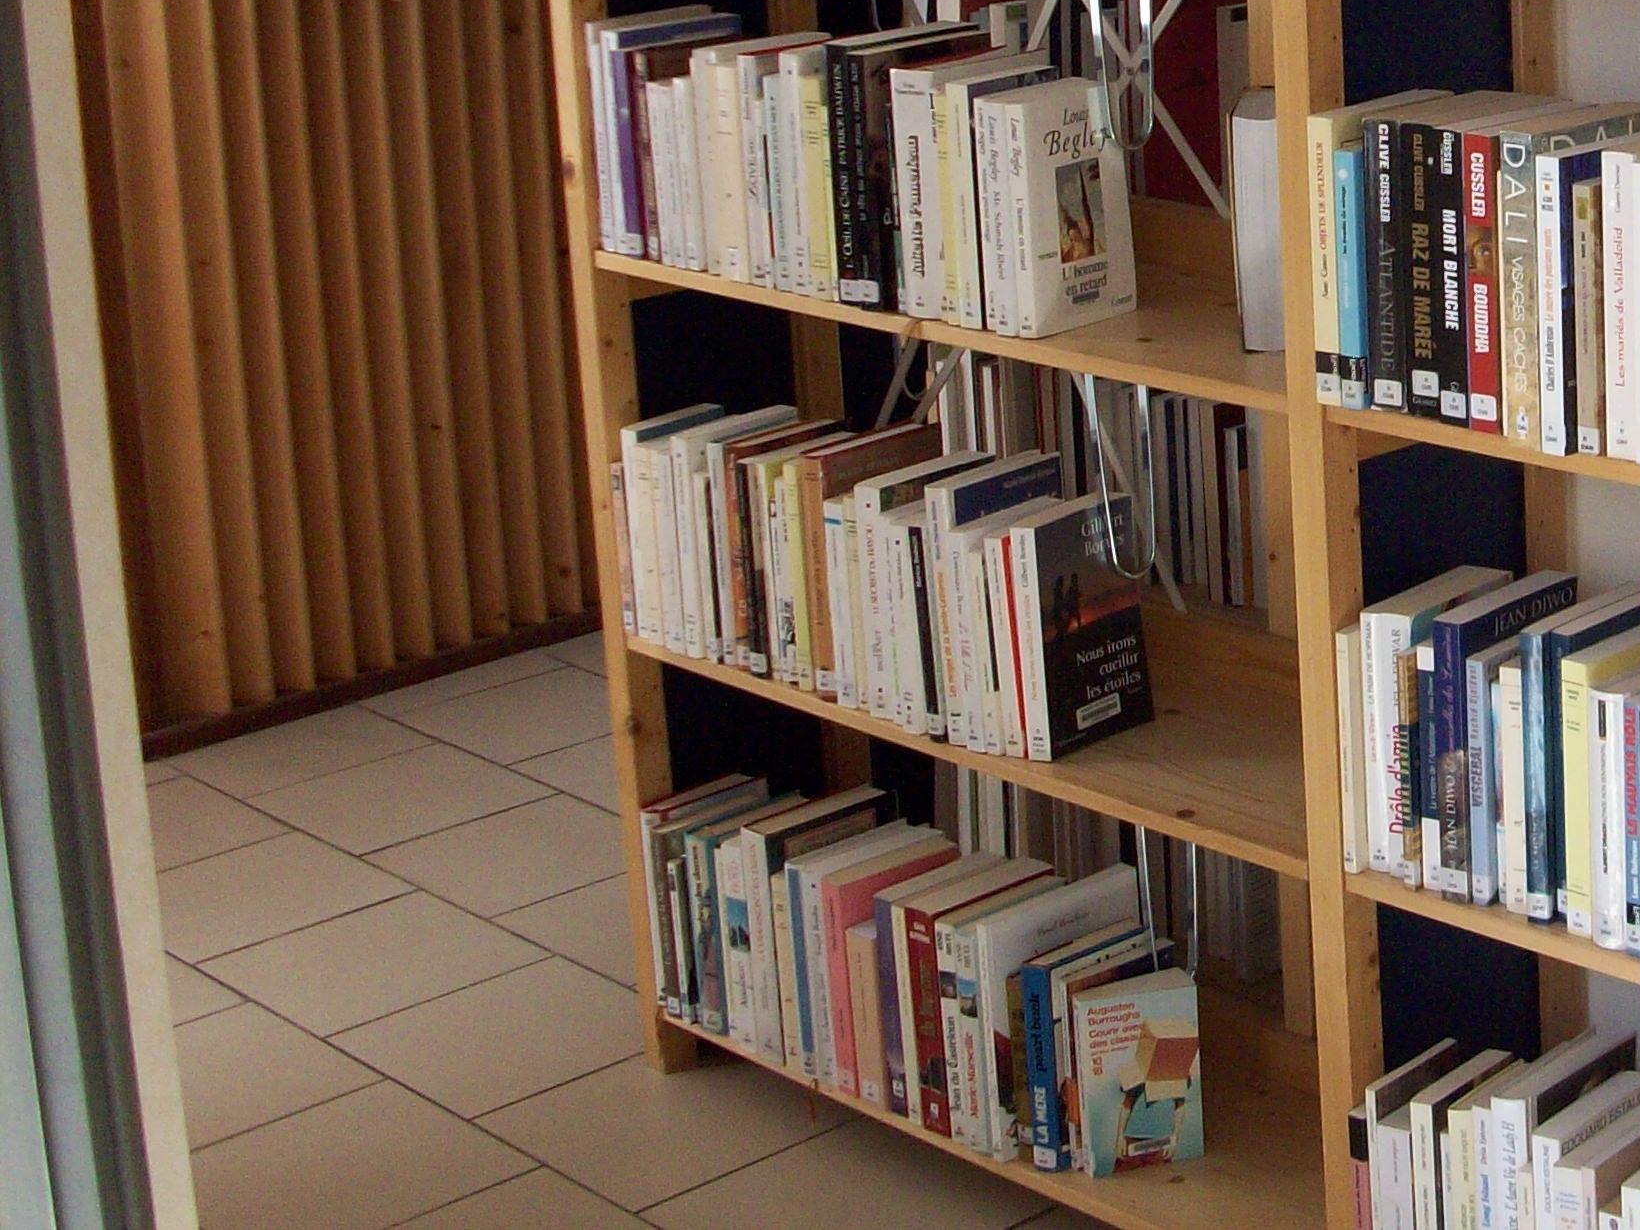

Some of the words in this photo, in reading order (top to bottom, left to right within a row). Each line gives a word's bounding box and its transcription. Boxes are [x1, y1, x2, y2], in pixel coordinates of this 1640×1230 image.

[1377, 123, 1390, 169] CLIVE
[1378, 173, 1391, 223] CUSSLER
[1470, 152, 1486, 218] CUSSLER
[1411, 222, 1430, 260] RAZ
[1442, 208, 1459, 254] MORT
[1413, 266, 1431, 291] DE
[1443, 259, 1459, 331] BLANCHE
[1377, 238, 1397, 371] ATLANTIDE
[1414, 295, 1438, 360] MARÉE
[1473, 283, 1489, 353] BOUDDHA
[1076, 647, 1104, 667] Nous
[1105, 634, 1137, 656] irons
[1100, 651, 1139, 676] cueillir
[1086, 684, 1102, 700] les
[1103, 670, 1142, 694] étoiles
